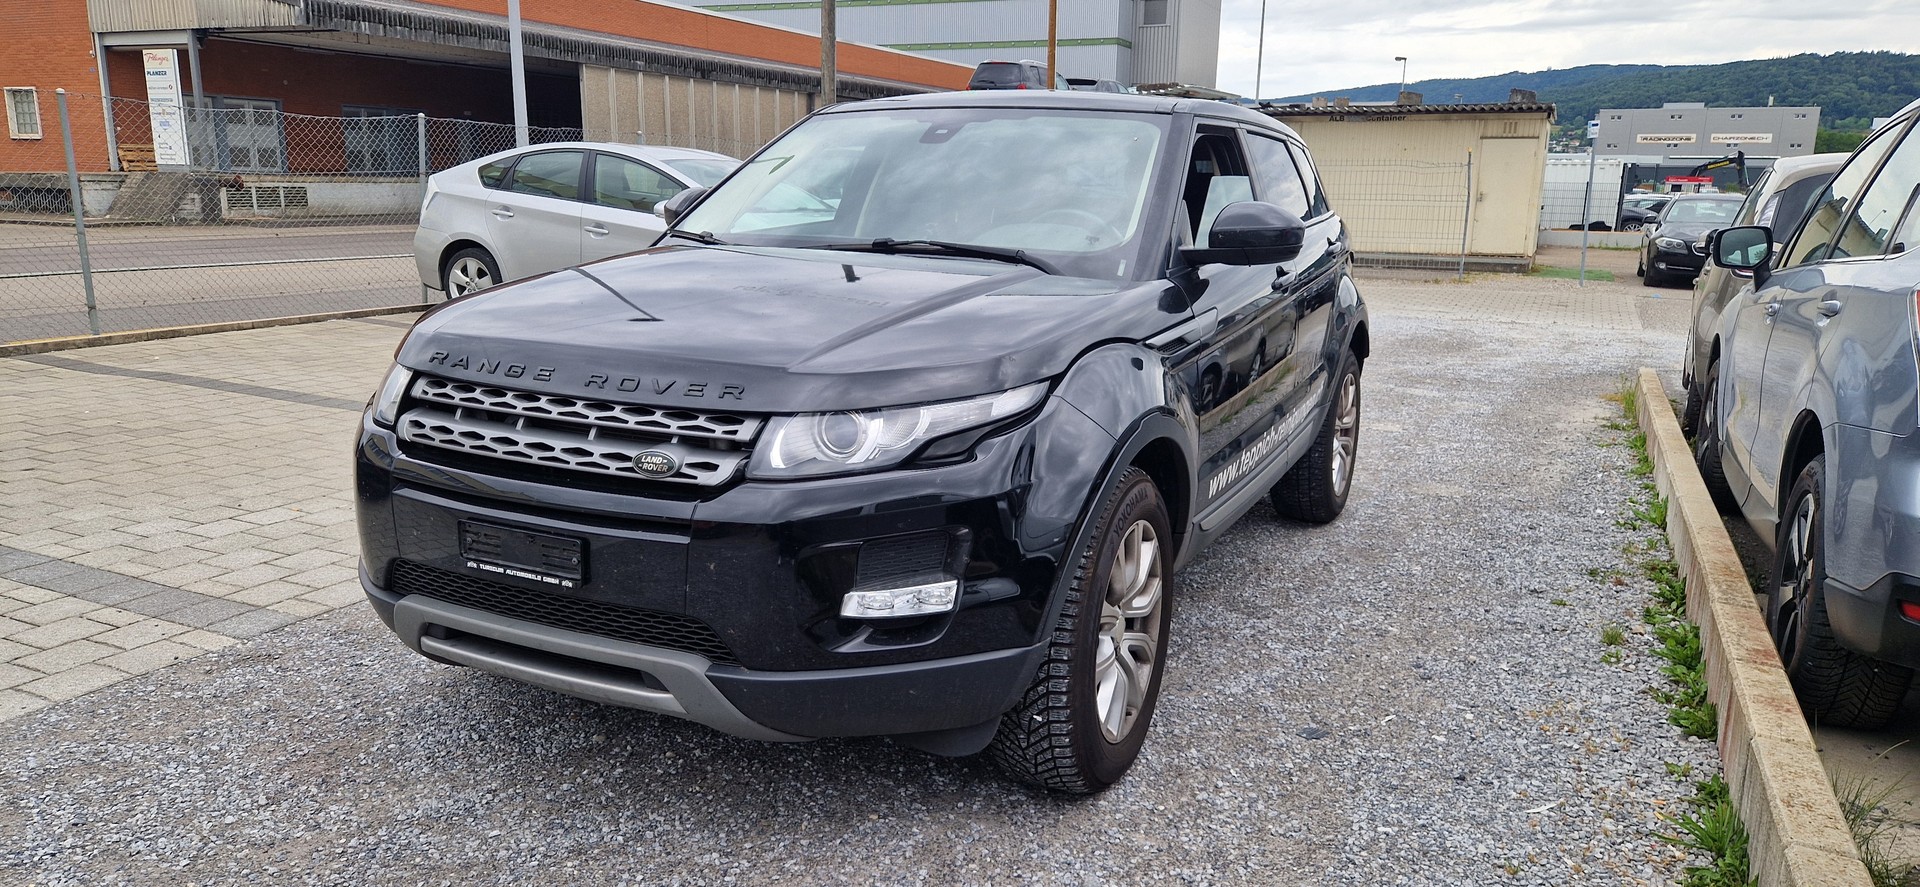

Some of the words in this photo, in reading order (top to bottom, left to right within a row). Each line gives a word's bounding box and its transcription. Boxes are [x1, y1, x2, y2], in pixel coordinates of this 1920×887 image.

[428, 350, 555, 382] RANGE
[584, 371, 745, 400] ROVER
[1114, 487, 1149, 537] YOKOHAMA
